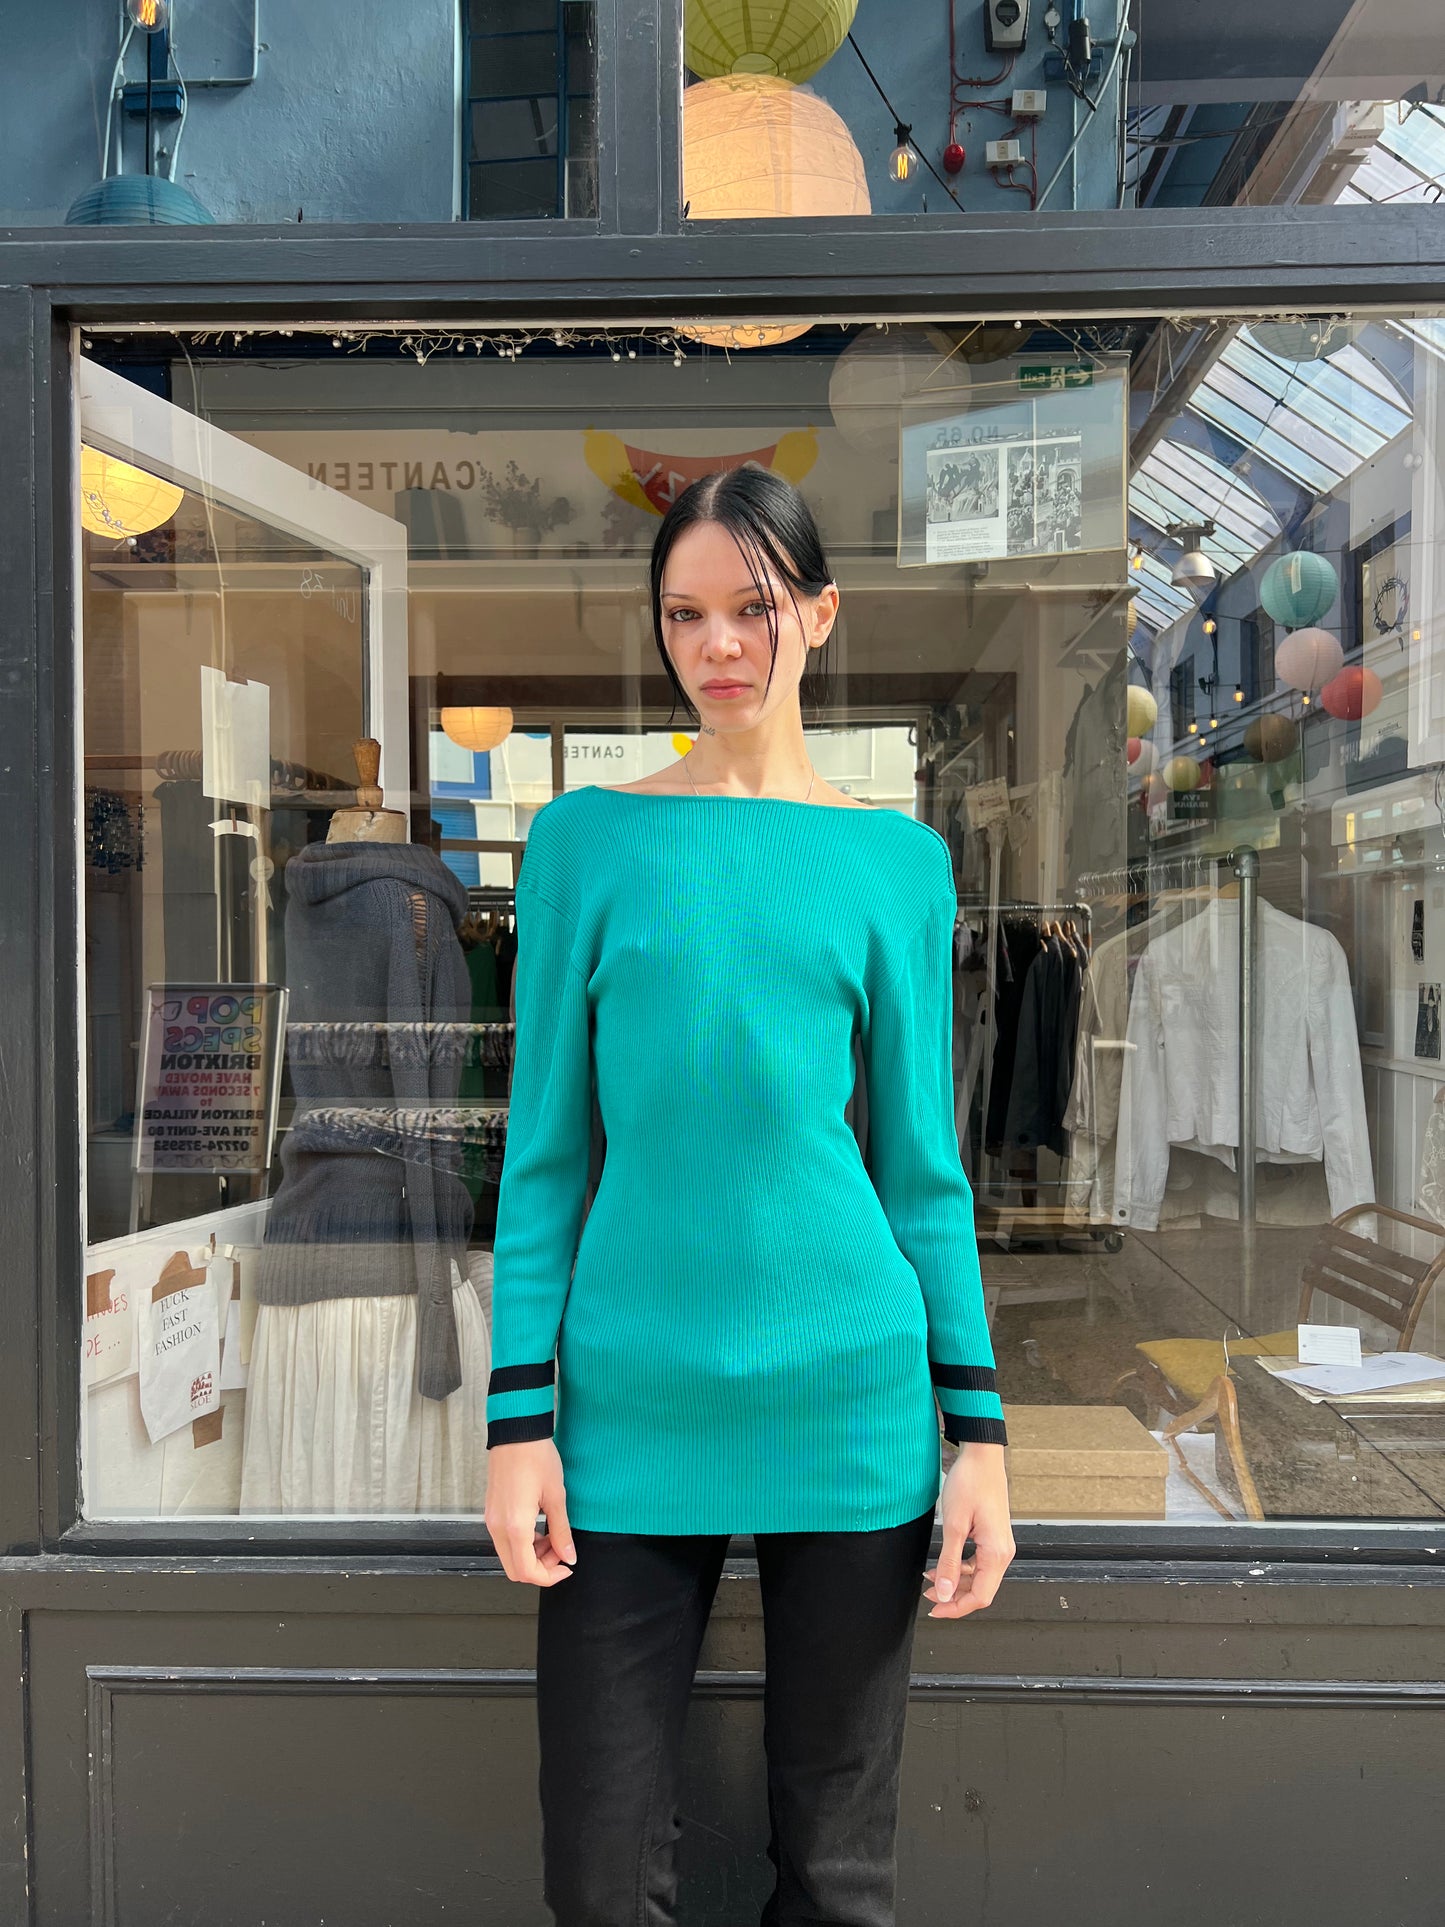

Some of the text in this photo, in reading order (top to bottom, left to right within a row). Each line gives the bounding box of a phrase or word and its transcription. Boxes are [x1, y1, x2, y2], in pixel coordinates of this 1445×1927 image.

[160, 1290, 190, 1313] FUCK
[162, 1308, 188, 1332] FAST
[155, 1322, 202, 1356] FASHION
[190, 1395, 212, 1411] SLOE
